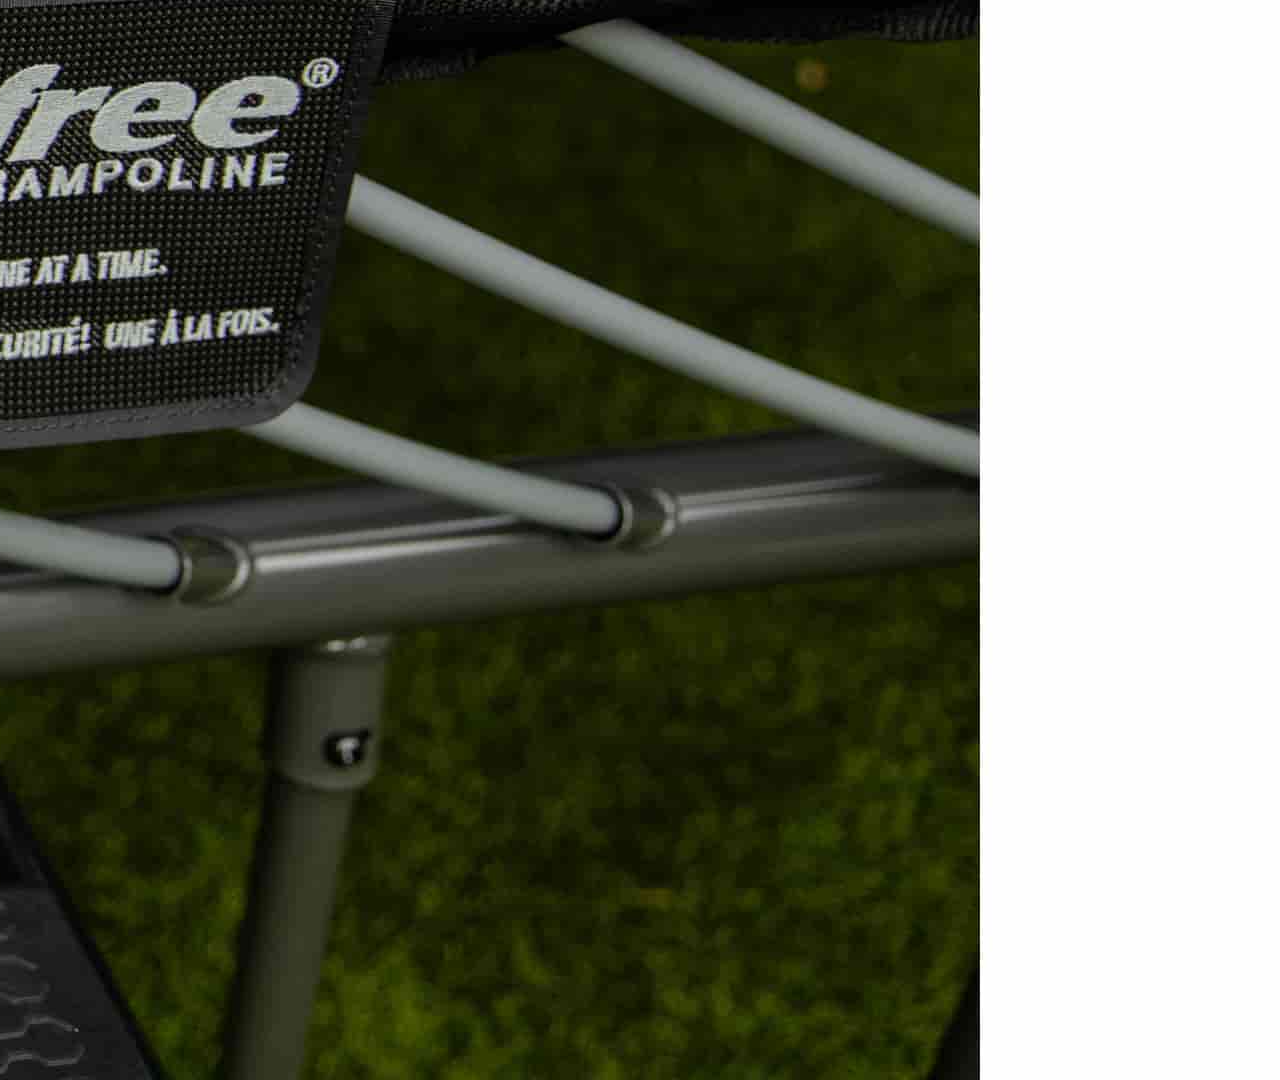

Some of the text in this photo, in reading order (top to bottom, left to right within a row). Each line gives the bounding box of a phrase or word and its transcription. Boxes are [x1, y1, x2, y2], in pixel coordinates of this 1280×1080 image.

[35, 255, 70, 285] AT
[71, 254, 92, 283] A
[97, 248, 168, 280] TIME.
[103, 320, 156, 350] UNE
[183, 313, 213, 343] LA
[217, 307, 280, 339] FOIS.
